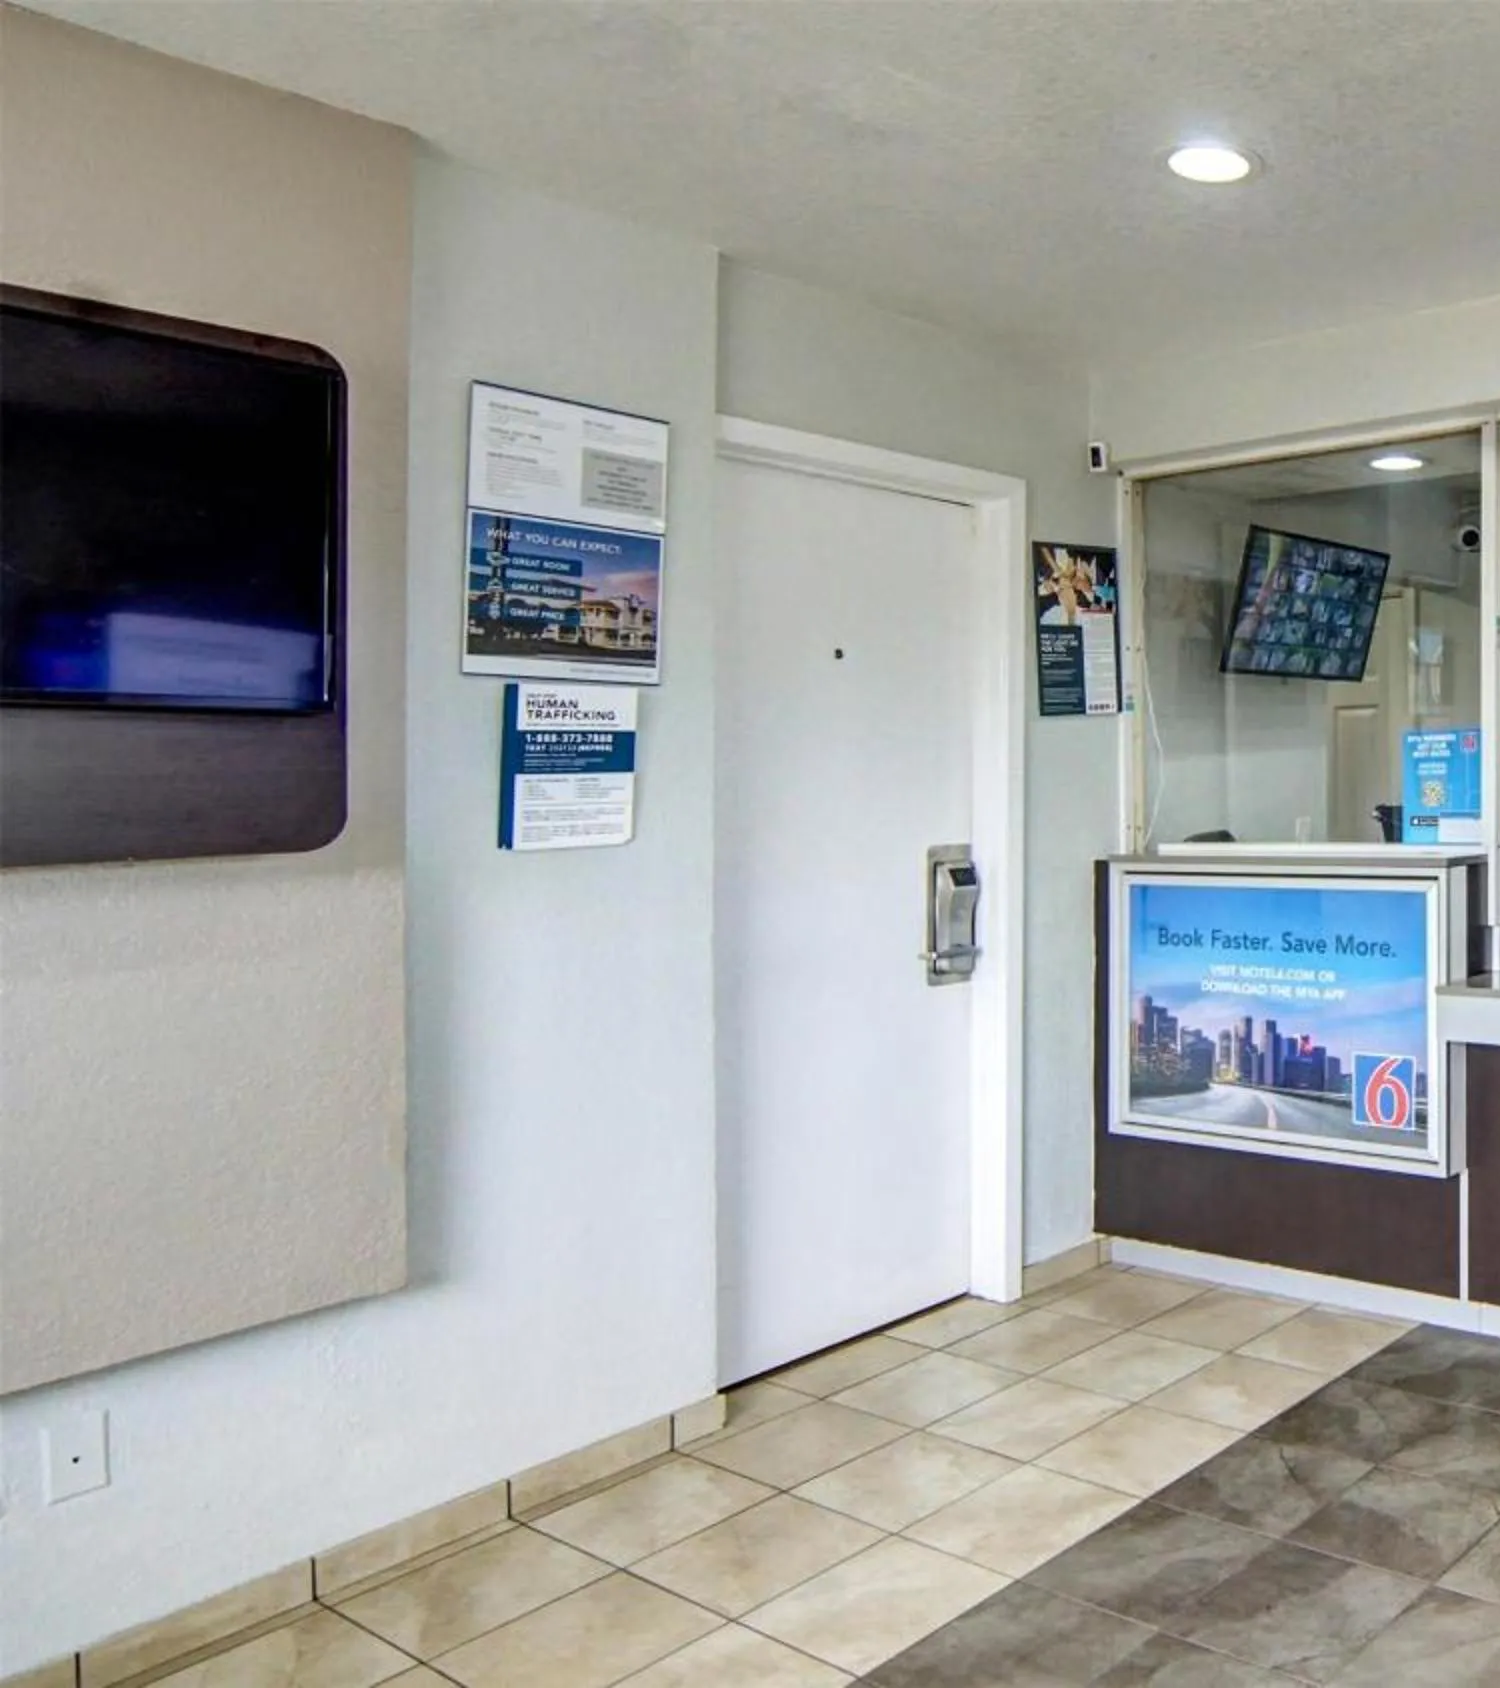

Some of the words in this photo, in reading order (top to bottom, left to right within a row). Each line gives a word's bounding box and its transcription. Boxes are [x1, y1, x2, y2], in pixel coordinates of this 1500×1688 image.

[486, 527, 522, 542] WHAT
[526, 533, 549, 546] YOU
[552, 537, 577, 550] CAN
[511, 556, 540, 568] GREAT
[527, 699, 579, 709] HUMAN
[527, 709, 616, 721] TRAFFICKING
[1158, 927, 1204, 949] Book
[1210, 928, 1273, 951] Faster.
[1281, 931, 1328, 954] Save
[1334, 933, 1397, 958] More.
[1317, 969, 1336, 983] OR
[1201, 978, 1268, 995] DOWNLOAD
[1271, 983, 1292, 998] THE
[1364, 1056, 1410, 1128] 6
